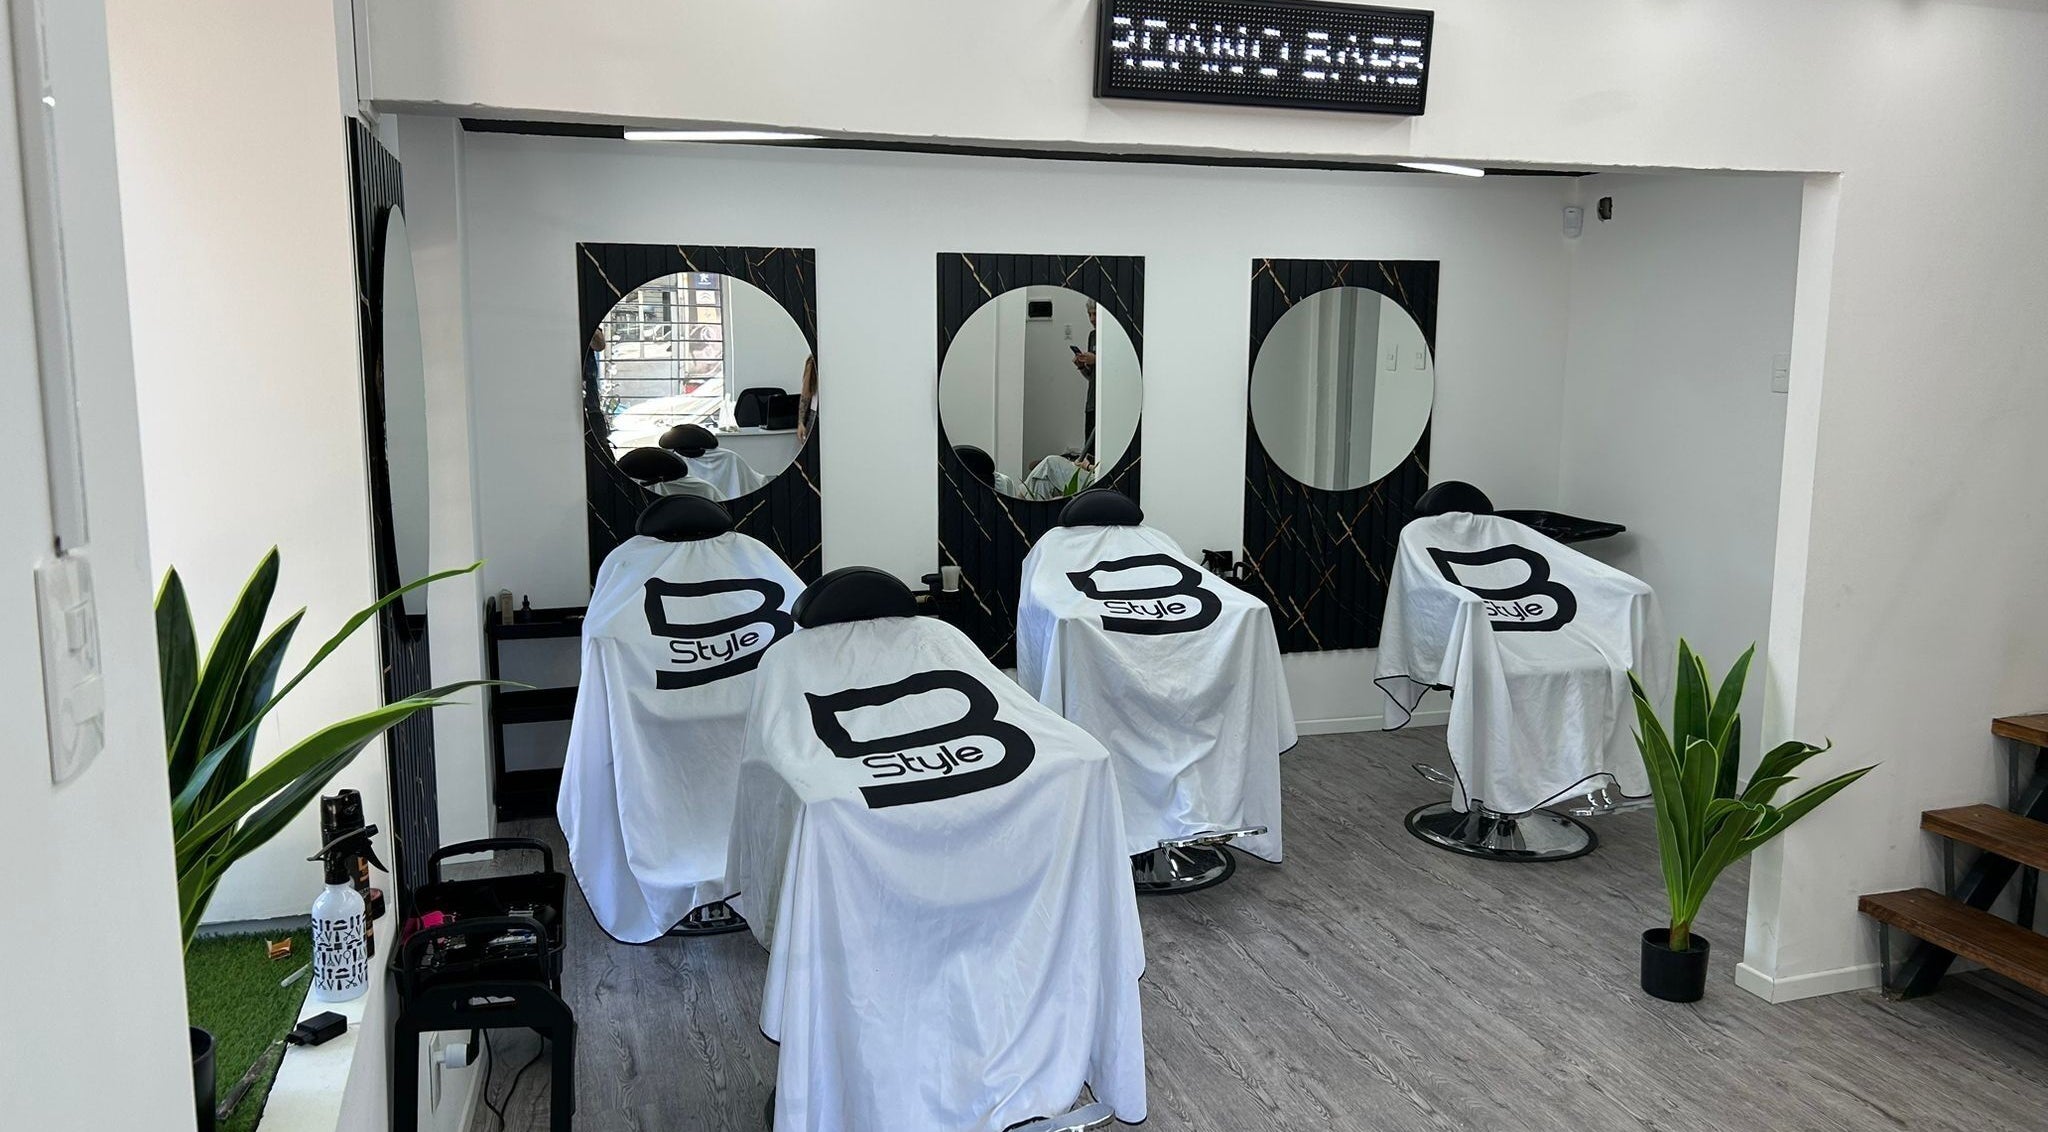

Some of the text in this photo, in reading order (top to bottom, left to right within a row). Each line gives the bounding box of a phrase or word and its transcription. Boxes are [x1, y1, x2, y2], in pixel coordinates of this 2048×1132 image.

[644, 577, 795, 690] B Style
[1066, 553, 1223, 635] B Style
[1426, 544, 1577, 632] B
[804, 670, 1036, 809] B Style
